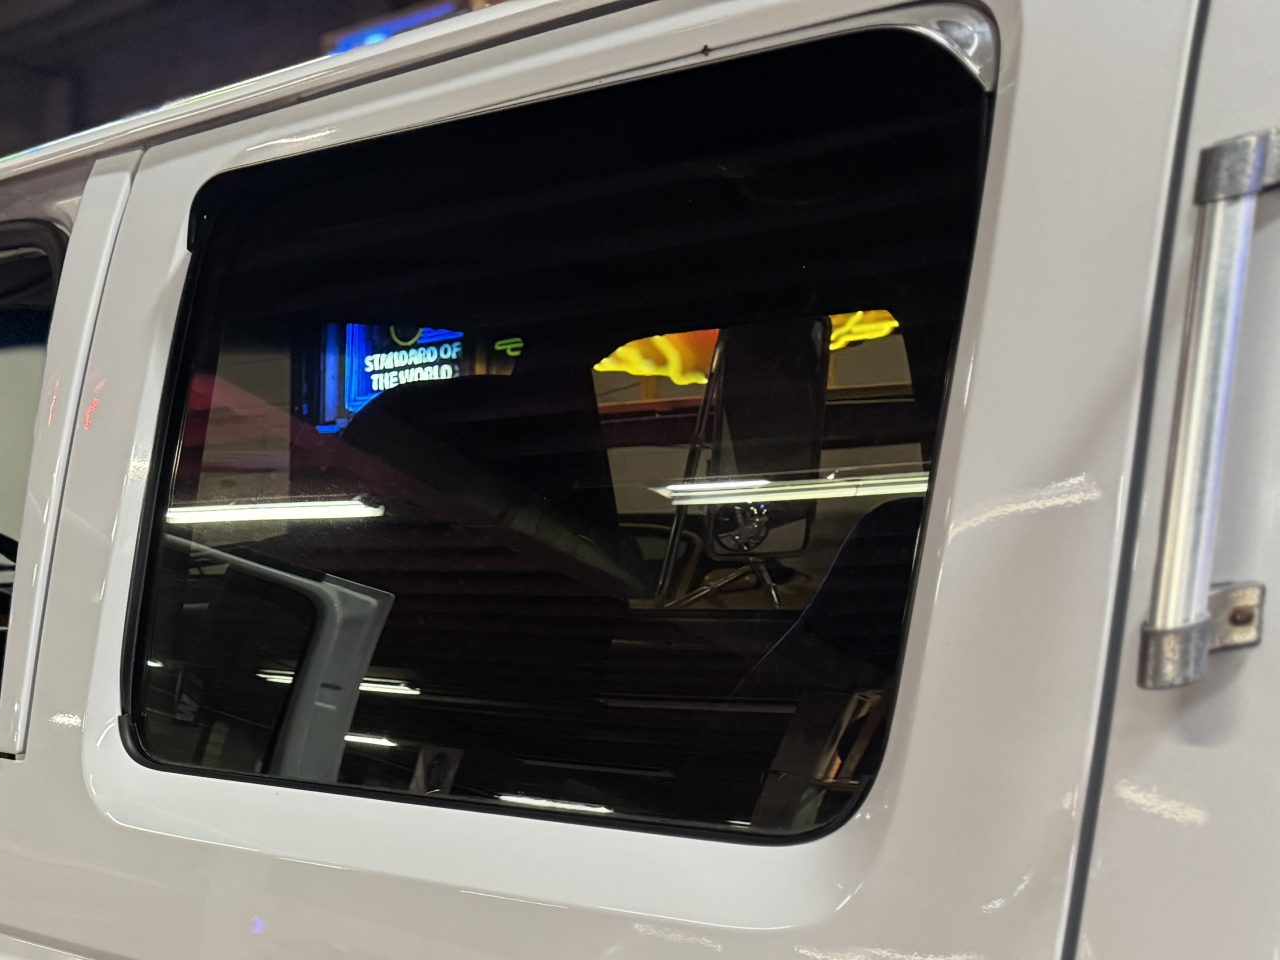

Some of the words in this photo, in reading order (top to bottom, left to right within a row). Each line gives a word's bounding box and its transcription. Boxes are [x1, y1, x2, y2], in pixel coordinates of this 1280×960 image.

[364, 346, 438, 372] STANDARD
[439, 341, 462, 359] OF
[370, 371, 399, 391] THE
[398, 364, 453, 385] WORLD
